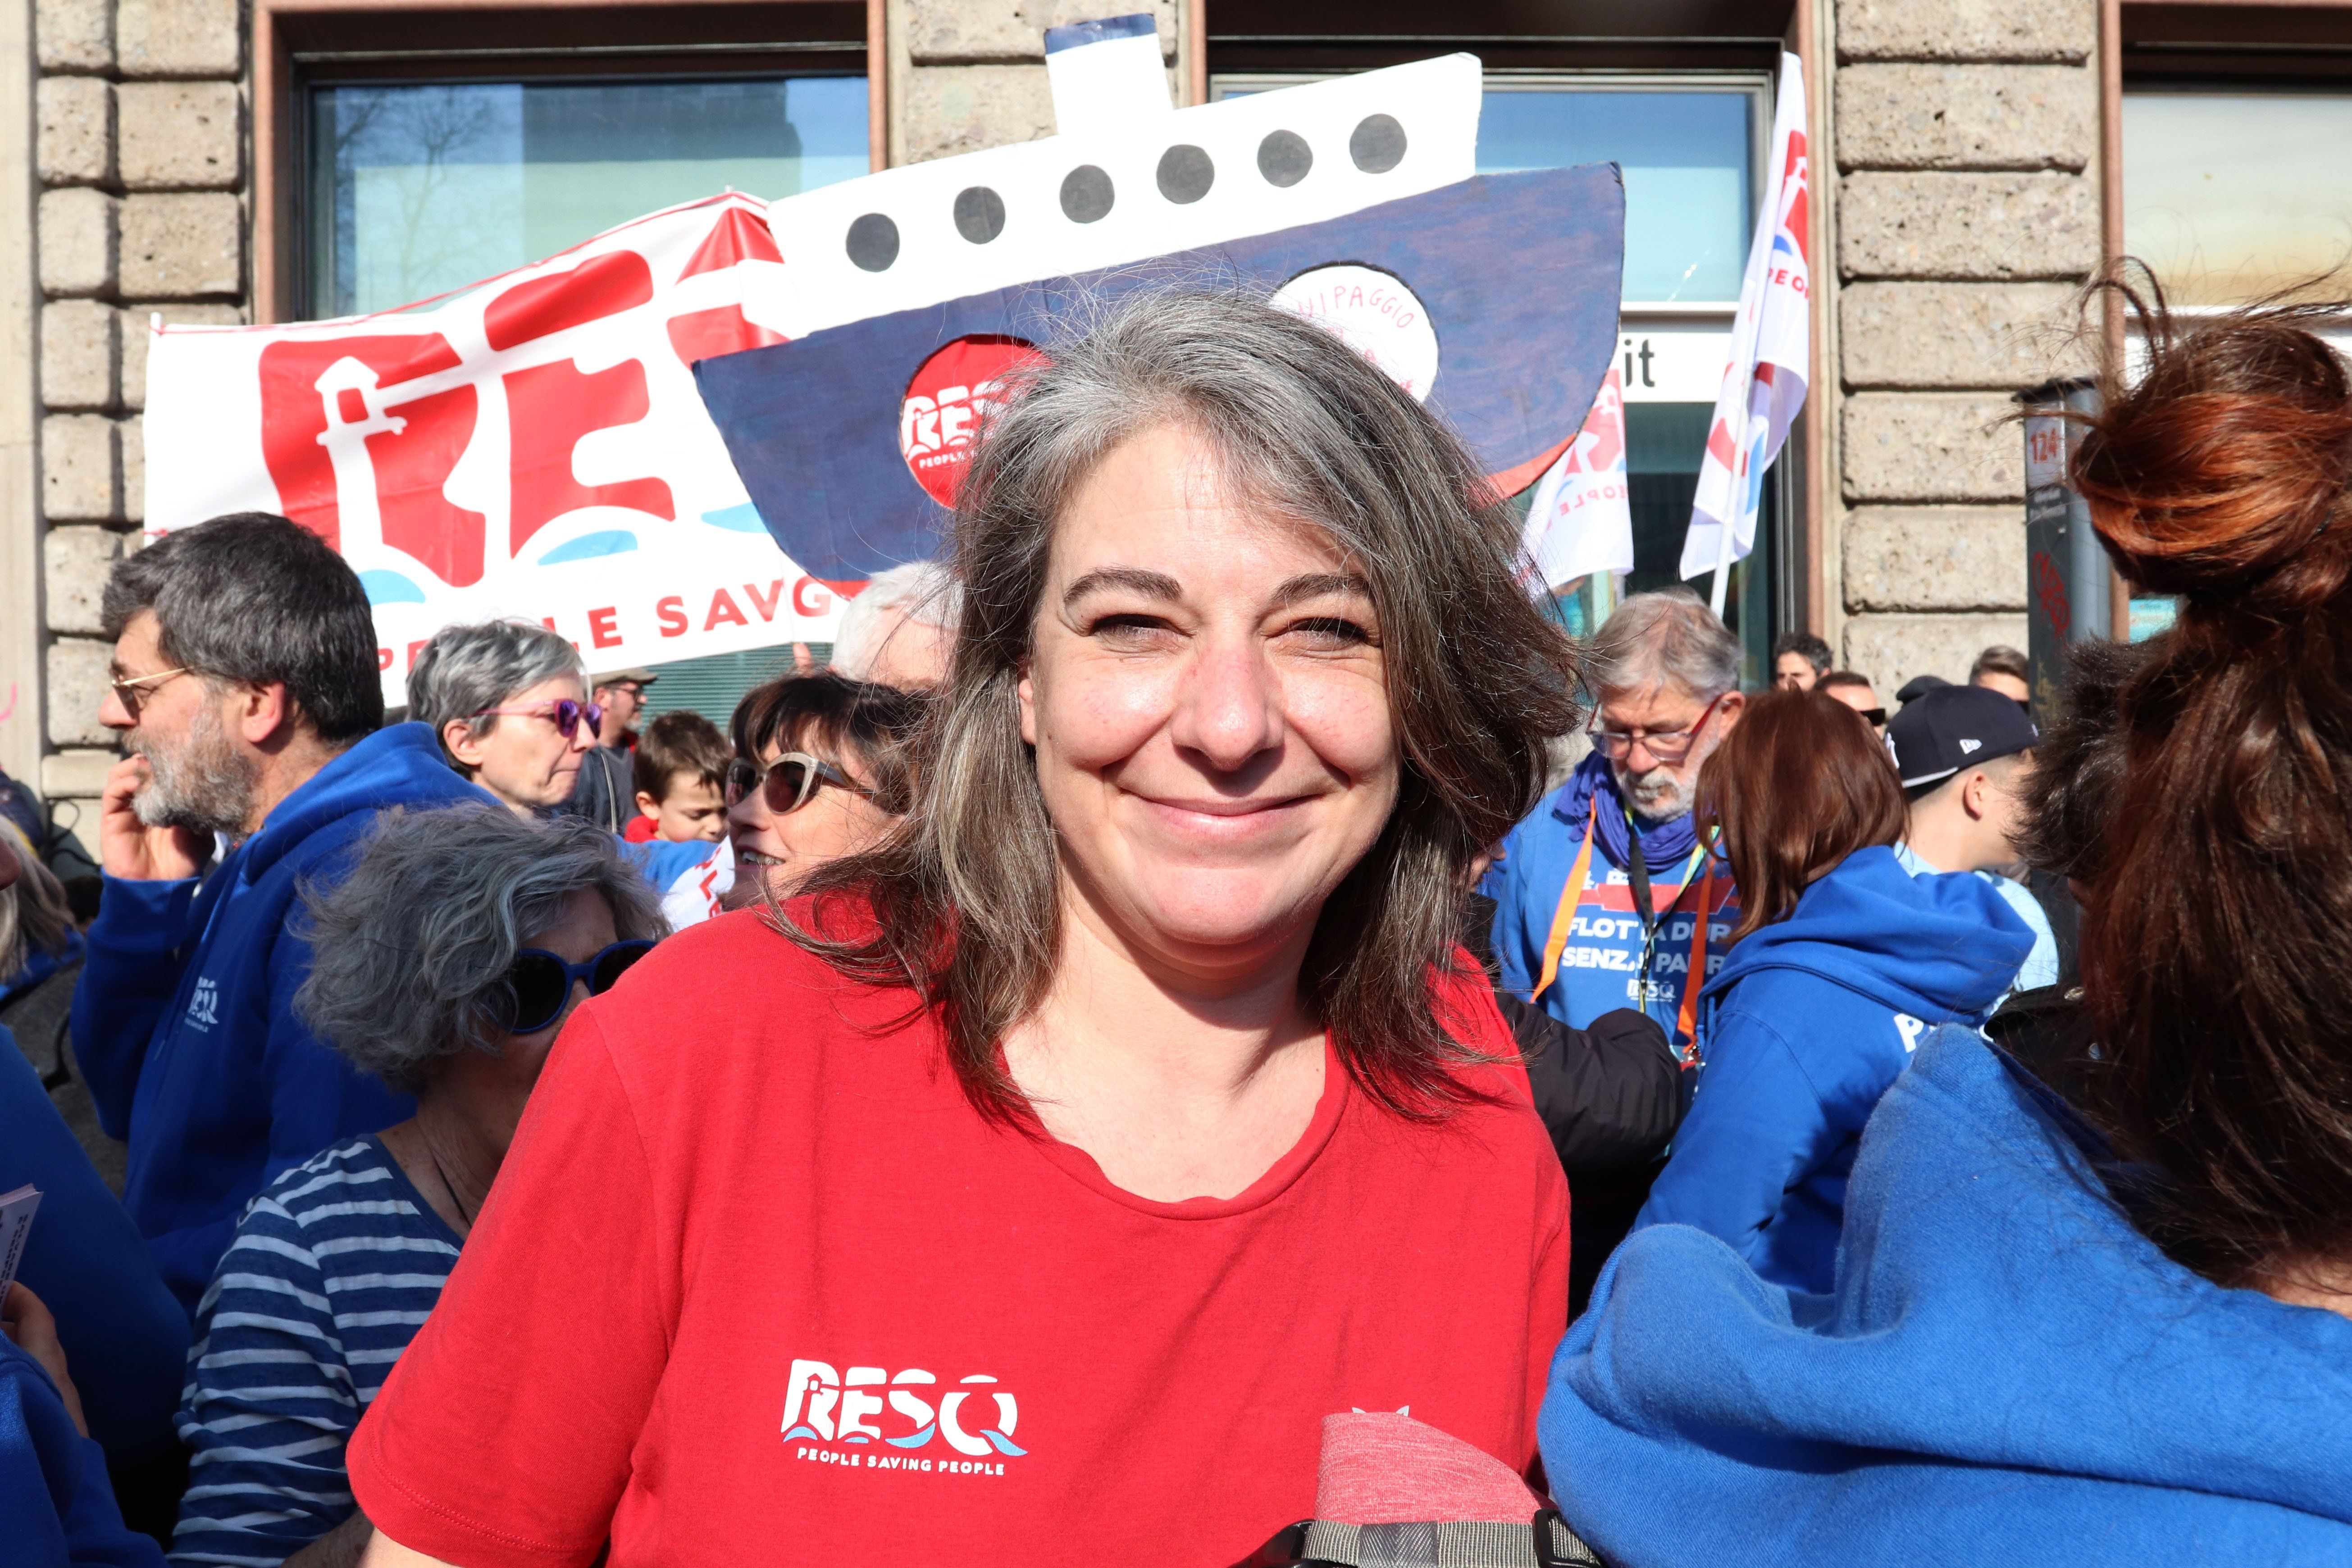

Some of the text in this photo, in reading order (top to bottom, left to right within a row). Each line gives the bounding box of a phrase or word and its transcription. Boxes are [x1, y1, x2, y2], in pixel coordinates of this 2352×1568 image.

[781, 1359, 1028, 1456] RESQ
[797, 1447, 1005, 1476] PEOPLE SAVING PEOPLE
